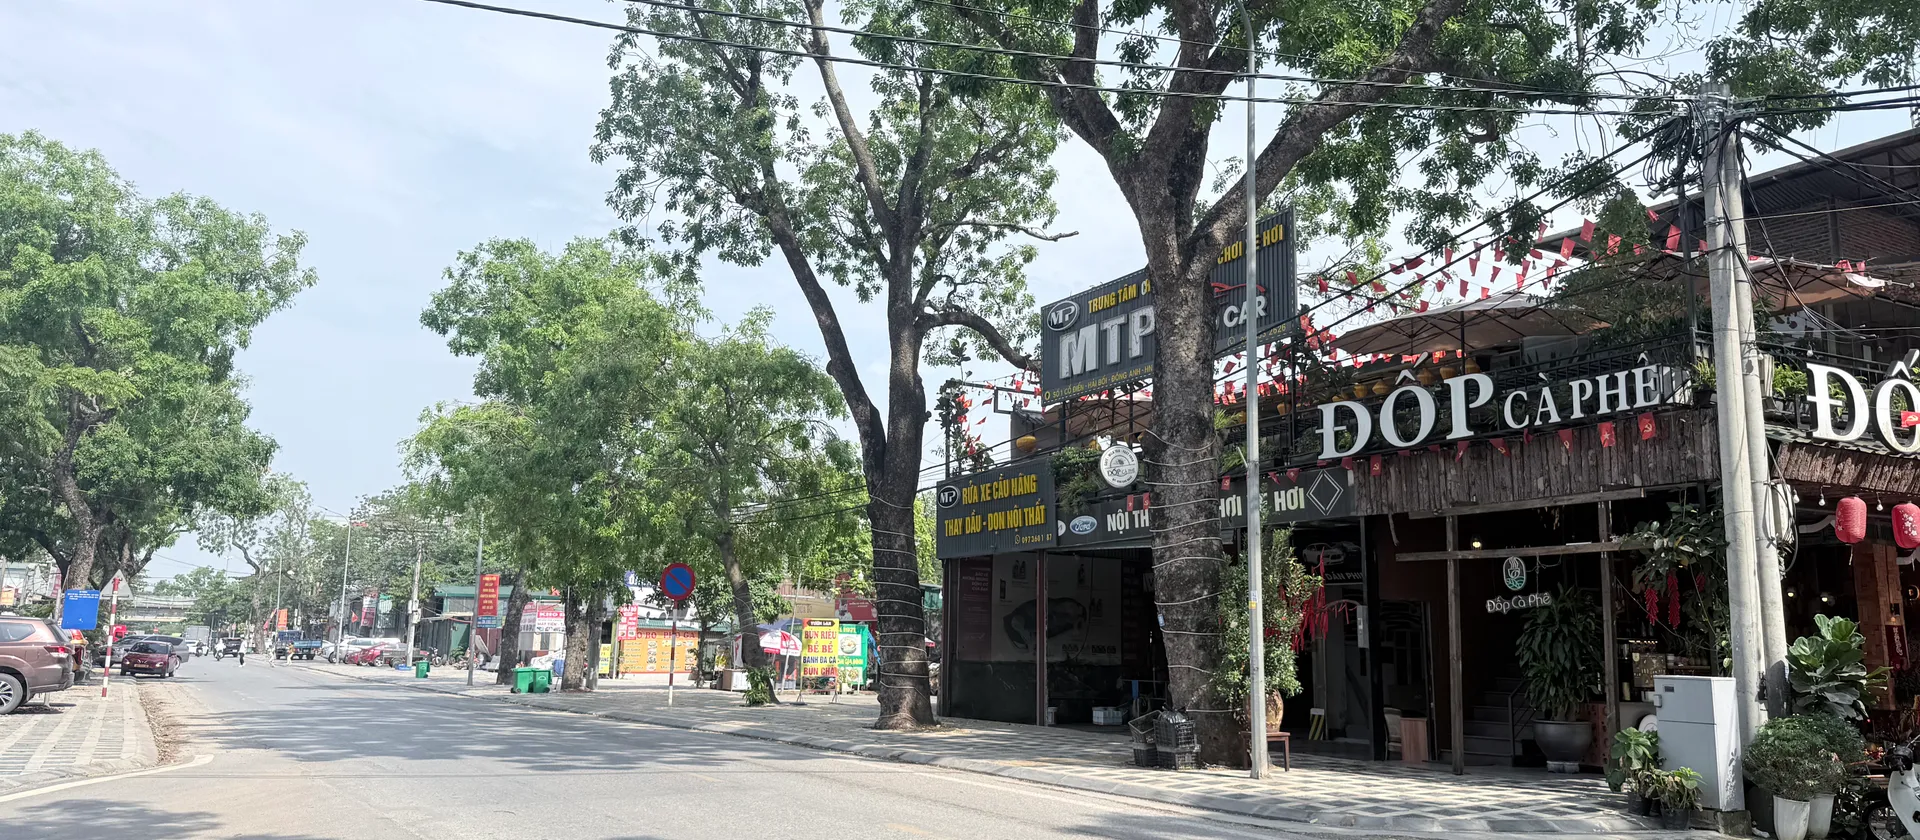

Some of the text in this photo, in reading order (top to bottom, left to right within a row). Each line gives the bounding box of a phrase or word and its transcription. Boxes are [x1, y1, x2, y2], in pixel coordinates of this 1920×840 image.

[1088, 292, 1116, 313] TRUNG
[1117, 284, 1137, 303] TÂM
[1263, 224, 1284, 247] HƠI
[1050, 305, 1076, 327] MTP
[1223, 295, 1268, 327] CAR
[1315, 352, 1661, 460] ĐỐP CÀ PHÊ
[962, 480, 978, 505] RỬA
[980, 483, 991, 502] XE
[1011, 472, 1037, 496] NÂNG
[945, 517, 963, 537] THAY
[987, 512, 1005, 535] DỌN
[1007, 504, 1023, 532] NỘI
[1024, 498, 1046, 527] THẤT
[1107, 509, 1129, 534] NỘI
[1273, 486, 1306, 512] HƠI
[1486, 592, 1551, 614] Đốp Cà Phê
